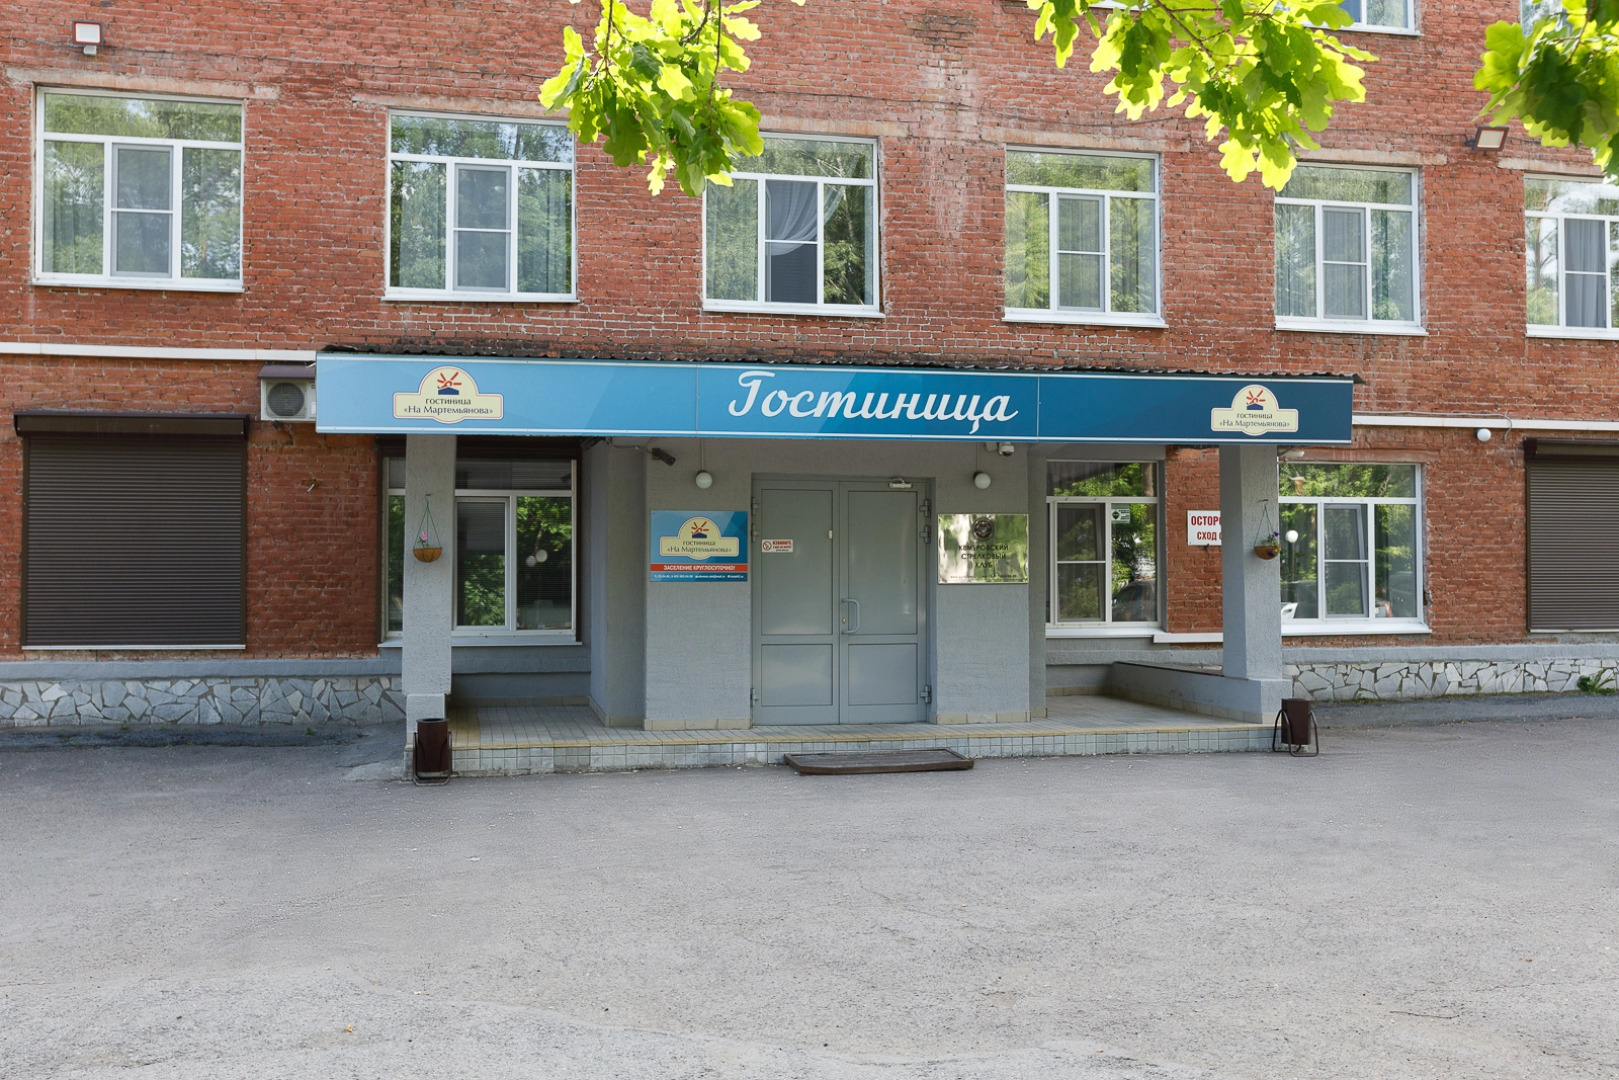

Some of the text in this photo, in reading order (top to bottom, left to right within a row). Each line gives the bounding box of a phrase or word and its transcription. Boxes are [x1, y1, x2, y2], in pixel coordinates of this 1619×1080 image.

[728, 371, 1018, 434] Гостиница
[404, 406, 493, 415] «На Мартемьянова»
[1219, 419, 1290, 429] «На Мартемьянова»
[1197, 531, 1217, 542] СХОД
